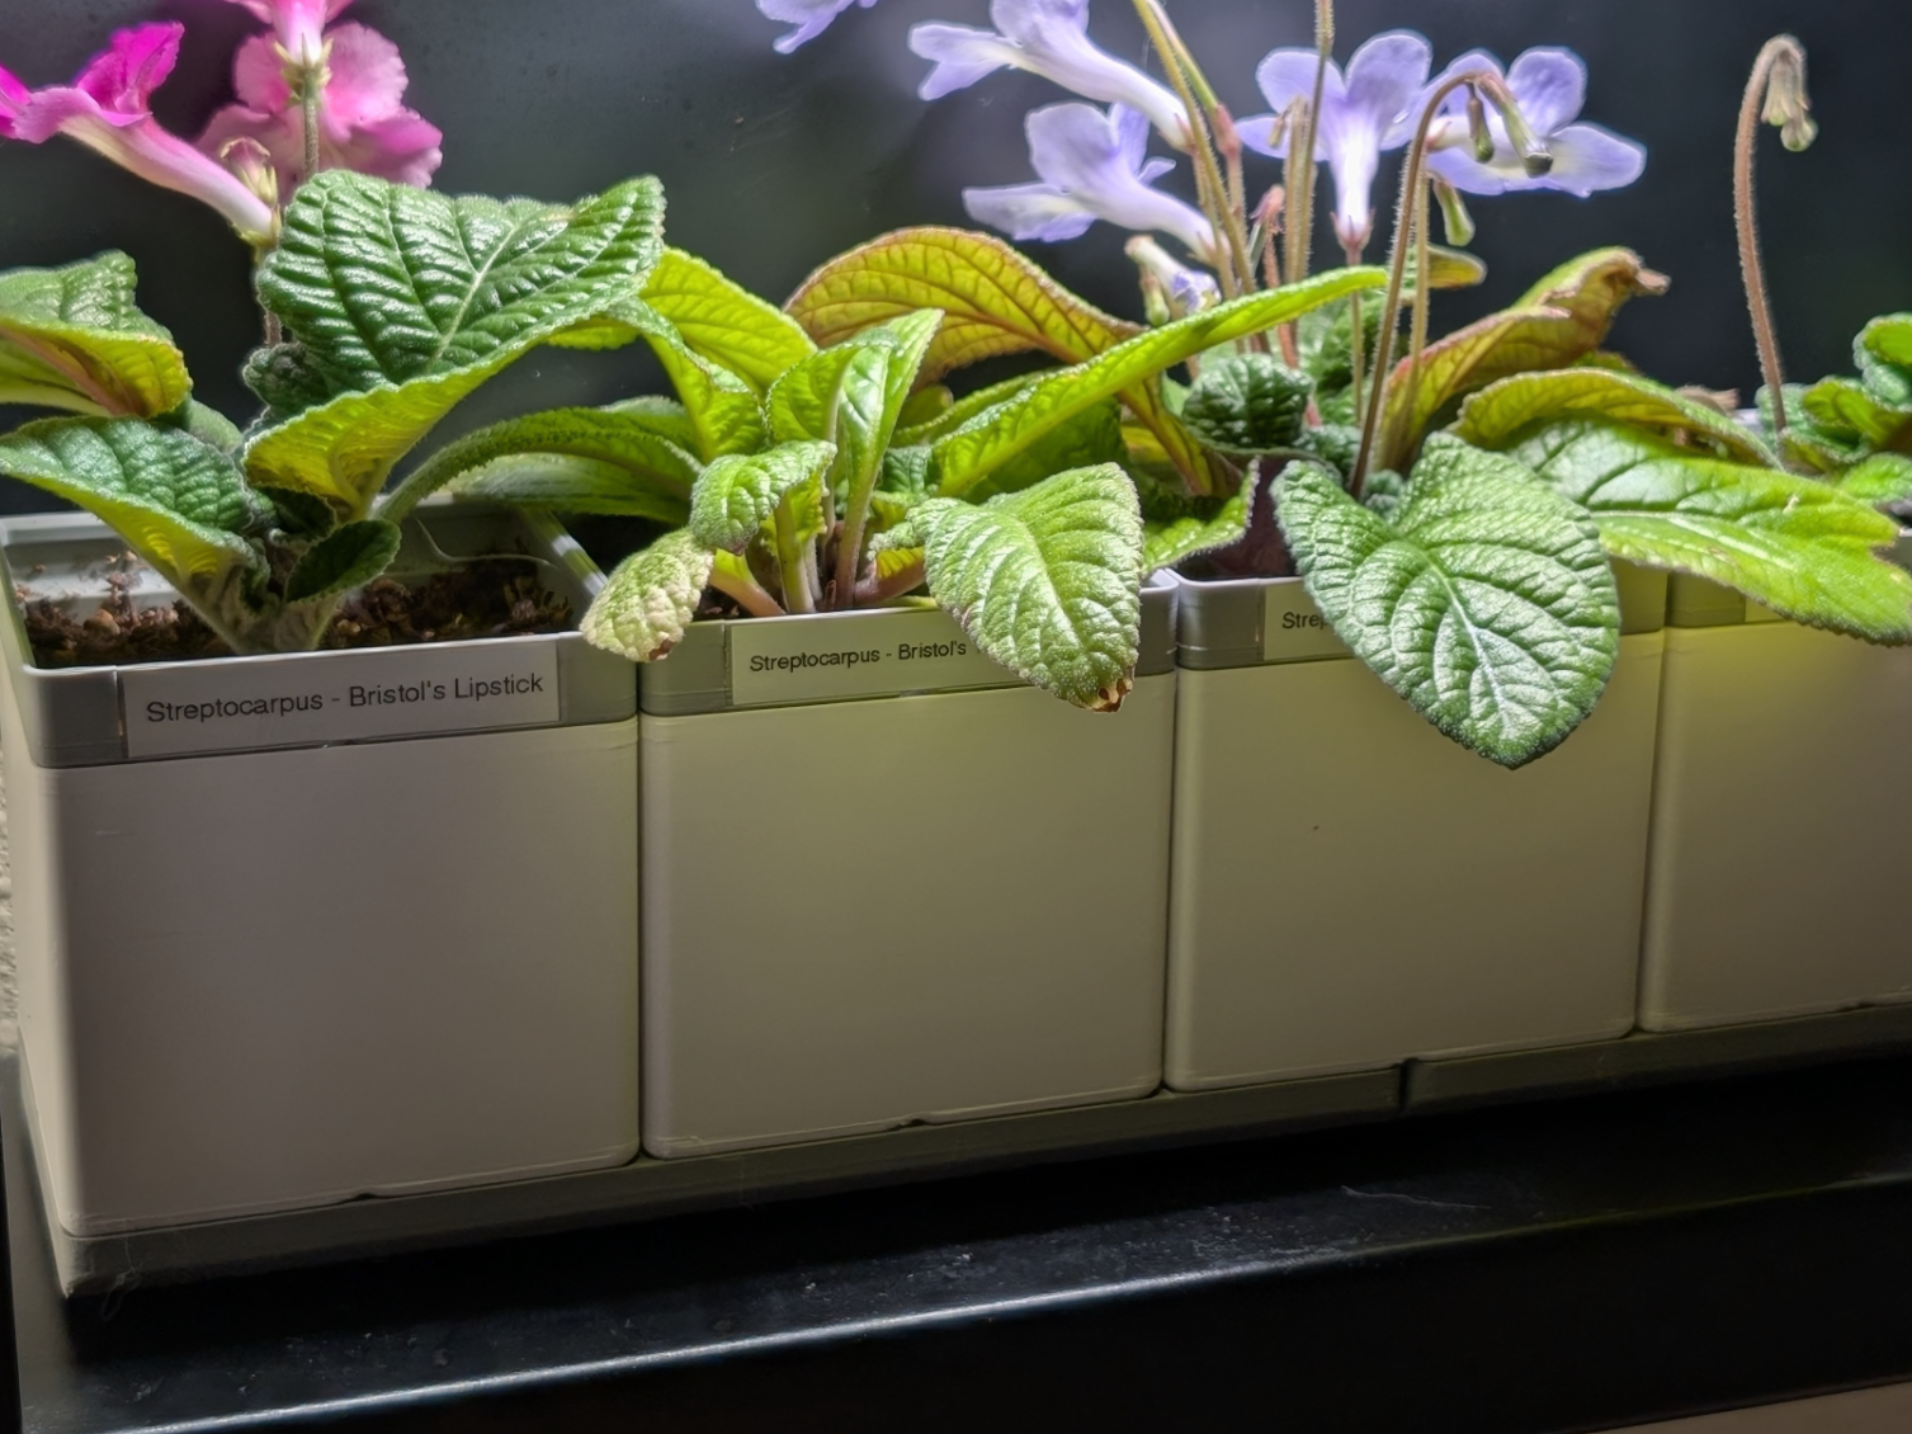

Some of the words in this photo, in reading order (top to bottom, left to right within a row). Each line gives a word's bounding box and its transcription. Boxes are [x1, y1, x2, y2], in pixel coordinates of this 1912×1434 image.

[750, 649, 880, 672] Streptocarpus
[898, 640, 967, 660] Bristol's
[147, 693, 323, 723] Streptocarpus
[349, 680, 446, 707] Bristol's
[455, 673, 543, 701] Lipstick
